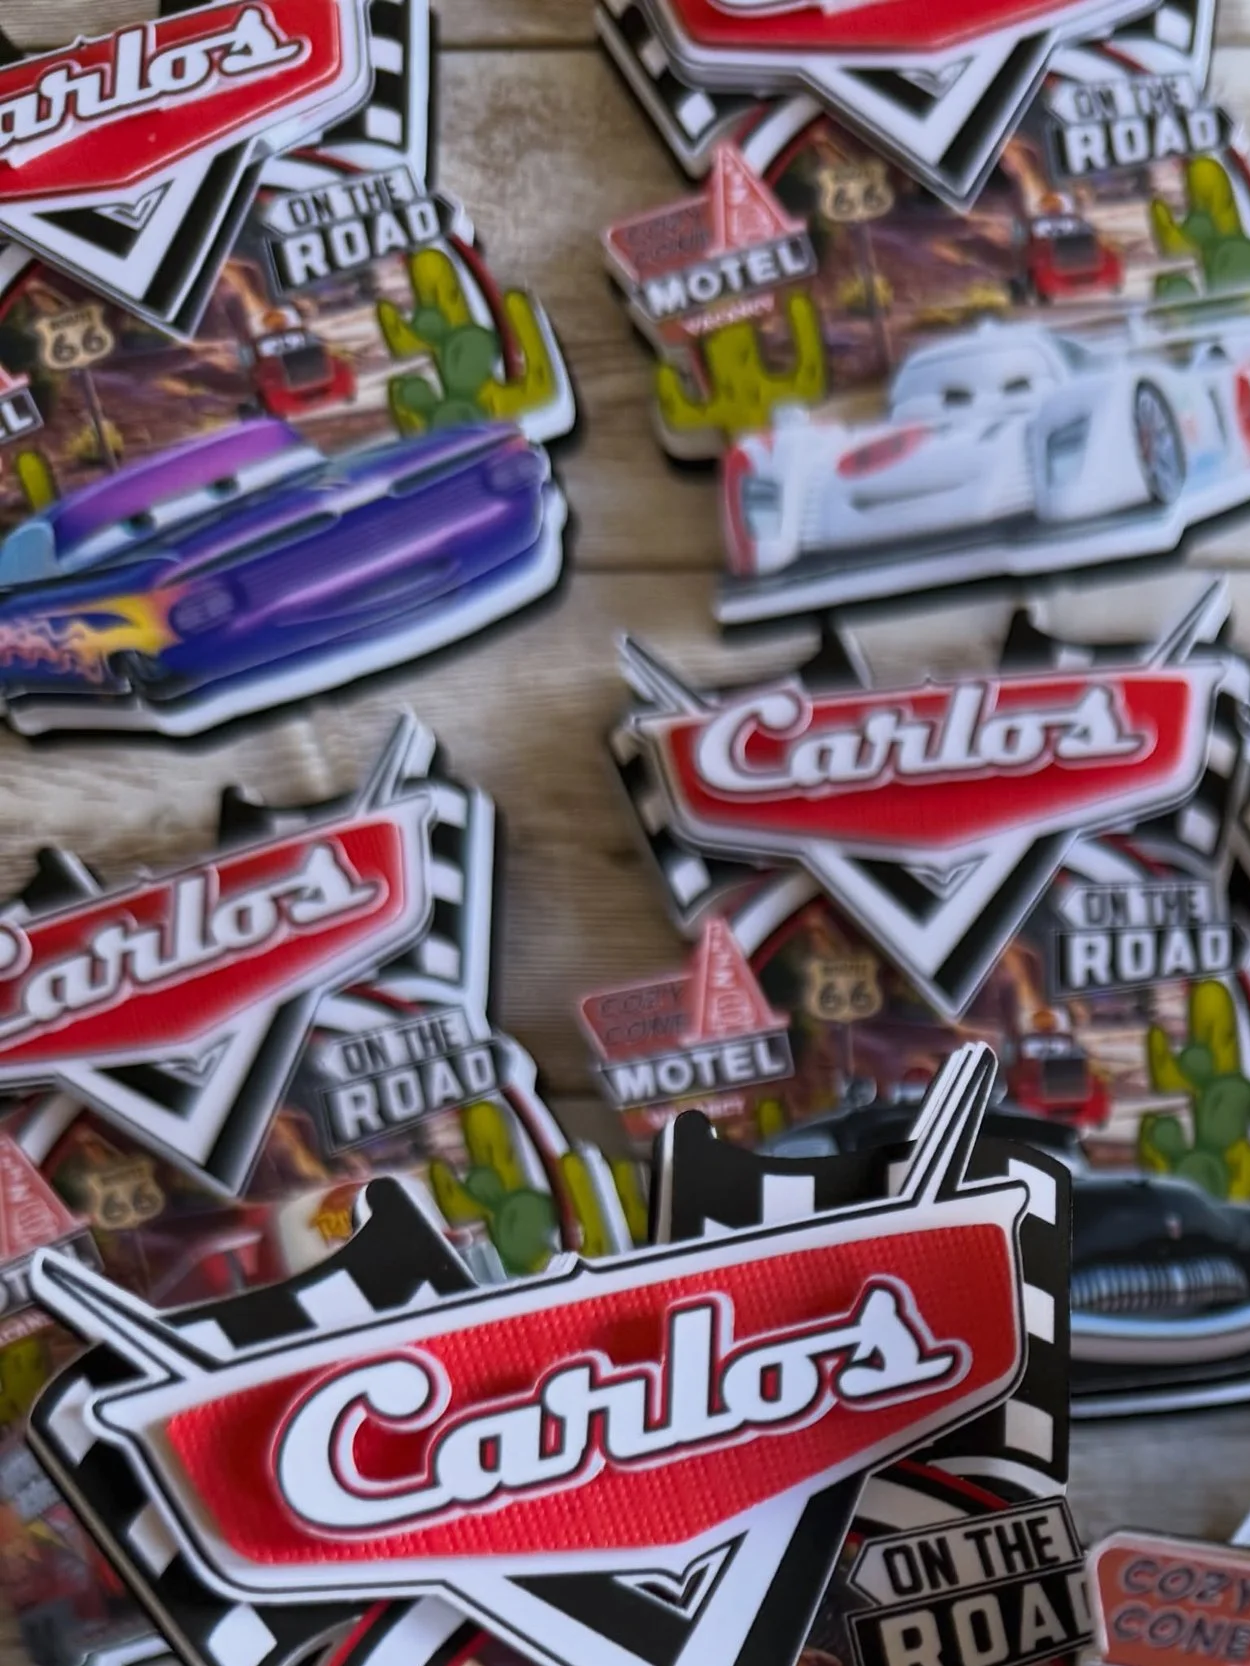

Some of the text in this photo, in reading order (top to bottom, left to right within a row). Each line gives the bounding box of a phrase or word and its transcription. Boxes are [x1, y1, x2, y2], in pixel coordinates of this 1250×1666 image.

[0, 8, 302, 148] arlos
[1065, 108, 1219, 175] ROAD
[288, 174, 402, 228] ON THE
[284, 202, 441, 286] ROAD
[645, 238, 809, 317] MOTEL
[53, 326, 108, 363] 66
[698, 683, 1143, 793] Carlos
[0, 844, 377, 1036] arlos
[1068, 925, 1232, 989] ROAD
[341, 1017, 459, 1075] ON THE
[613, 1037, 786, 1102] MOTEL
[337, 1047, 497, 1142] ROAD
[278, 1287, 954, 1530] Carlos
[882, 1515, 1062, 1598] ON THE
